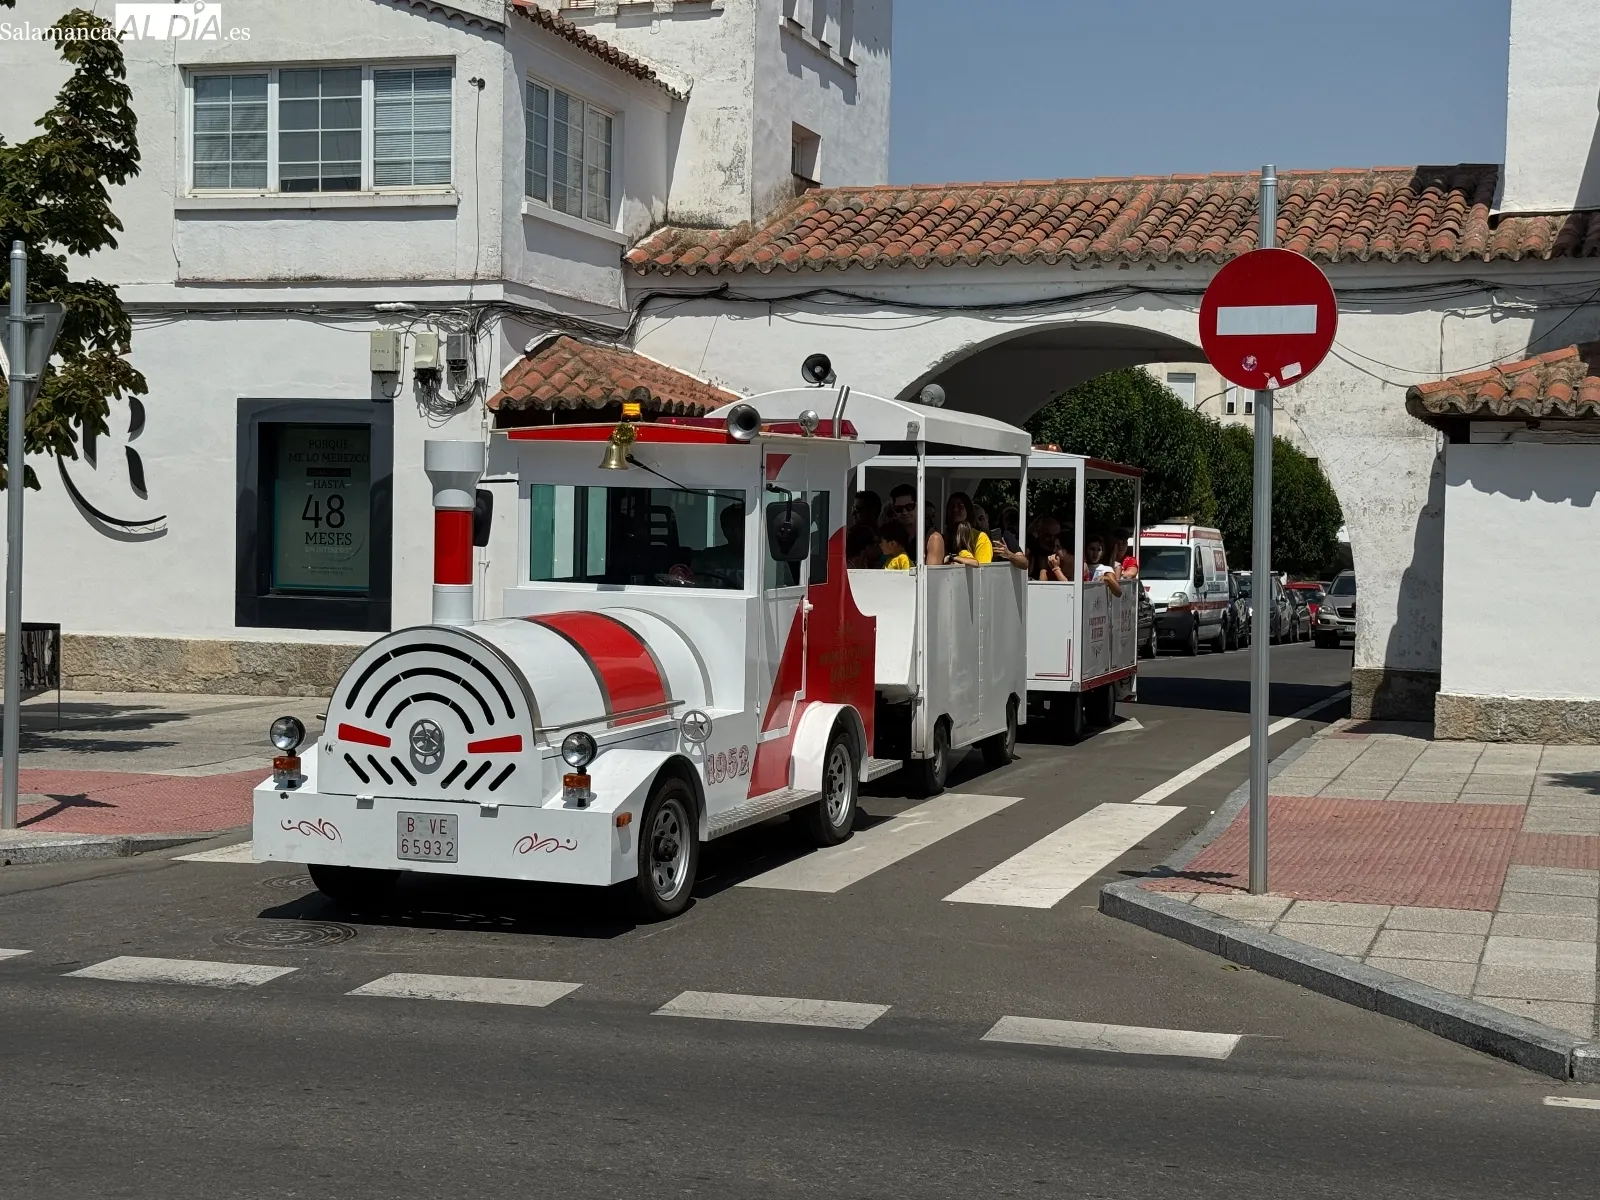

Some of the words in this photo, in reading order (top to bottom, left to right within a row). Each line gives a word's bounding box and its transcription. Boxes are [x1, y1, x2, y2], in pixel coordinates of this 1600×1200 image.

[309, 439, 348, 450] PORQUE
[289, 453, 304, 463] ME
[307, 453, 319, 463] LO
[322, 454, 369, 463] MEREZCO
[313, 480, 345, 488] HASTA
[302, 494, 345, 529] 48
[305, 532, 352, 545] MESES
[708, 744, 749, 786] 1952
[408, 817, 414, 832] B
[430, 818, 447, 834] VE
[401, 838, 454, 856] 65932
